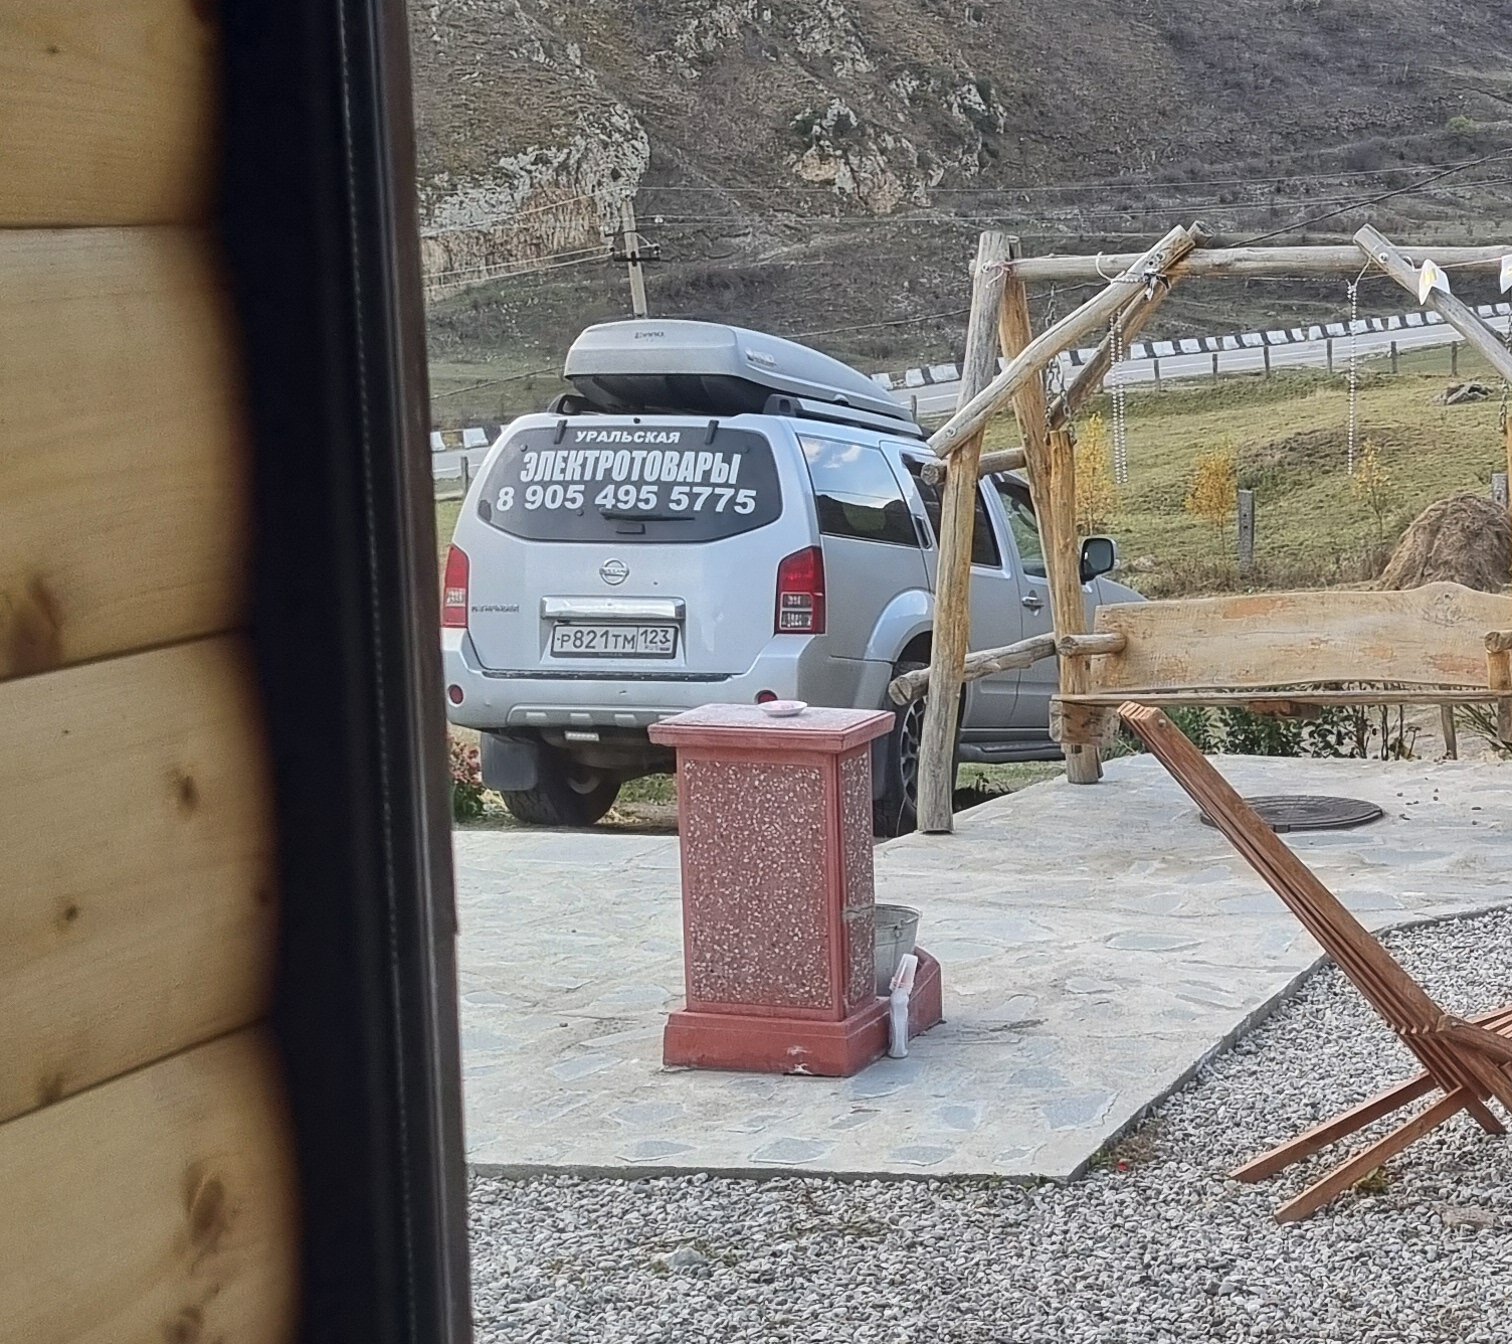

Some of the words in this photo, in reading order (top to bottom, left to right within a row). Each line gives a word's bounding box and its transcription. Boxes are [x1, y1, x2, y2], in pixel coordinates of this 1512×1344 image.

[575, 431, 680, 444] УРАЛЬСКАЯ
[520, 450, 742, 484] ЭЛЕКТРОТОВАРЫ
[497, 487, 515, 511] 8
[524, 484, 585, 510] 905
[595, 484, 658, 510] 495
[669, 486, 757, 514] 5775
[640, 629, 671, 645] 123
